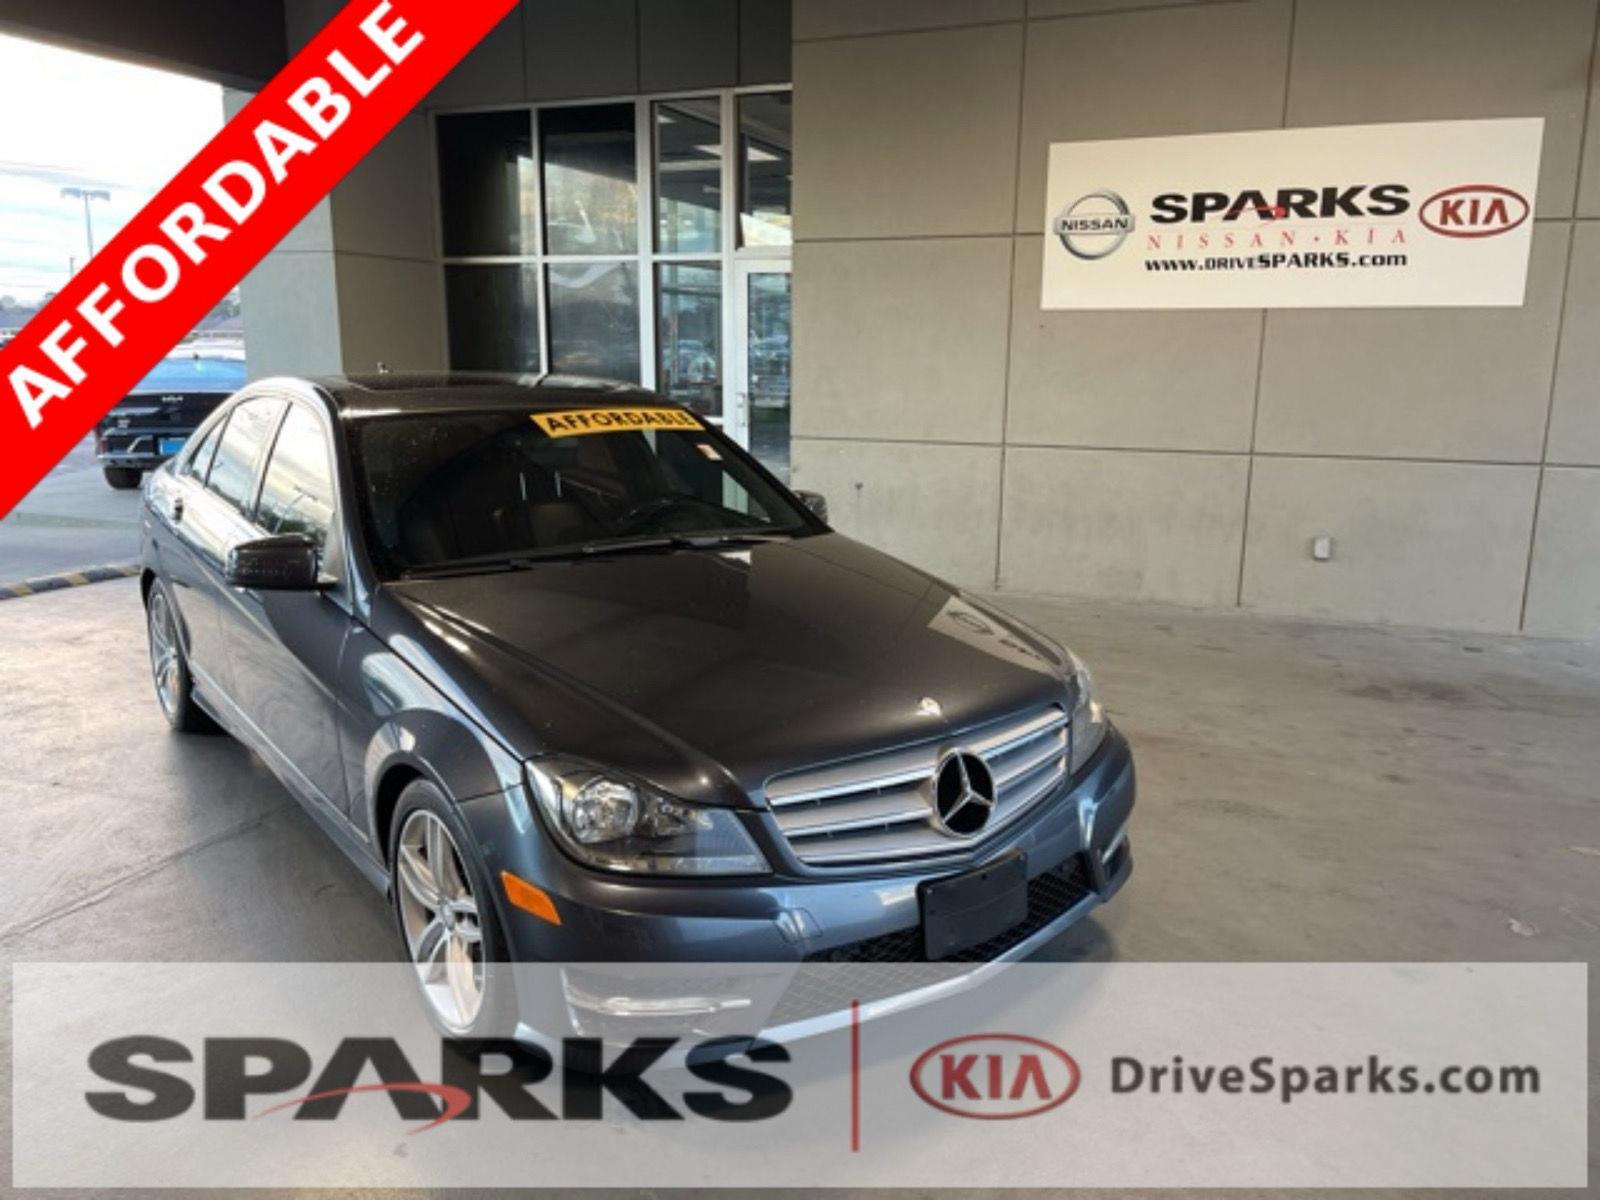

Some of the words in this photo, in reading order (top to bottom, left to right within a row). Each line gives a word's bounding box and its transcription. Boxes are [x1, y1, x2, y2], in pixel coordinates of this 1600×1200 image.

[1150, 184, 1410, 223] SPARKS
[1439, 198, 1509, 225] KIA
[1061, 218, 1128, 230] NISSAN
[546, 411, 696, 431] AFFORDABLE
